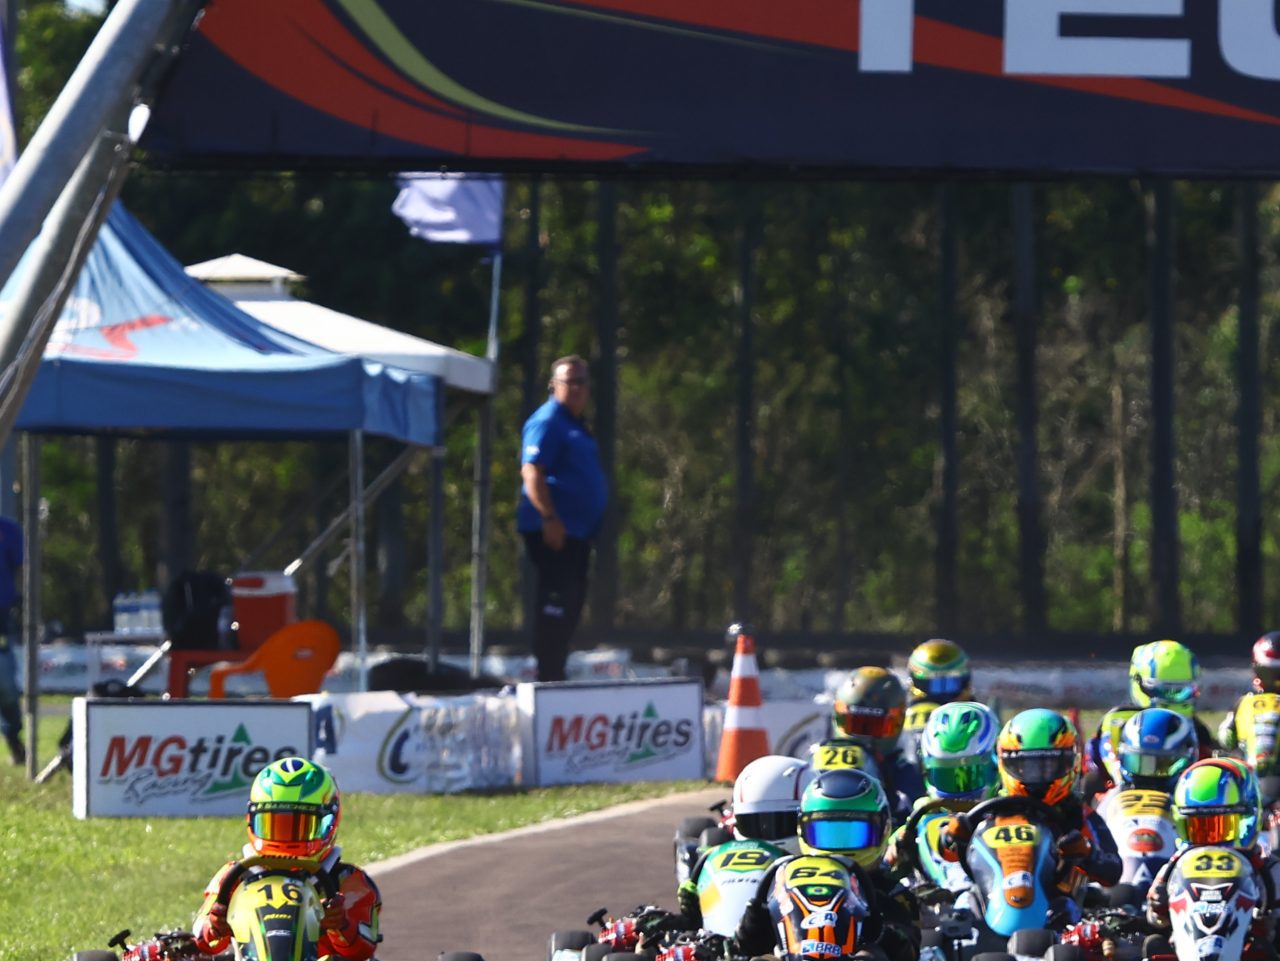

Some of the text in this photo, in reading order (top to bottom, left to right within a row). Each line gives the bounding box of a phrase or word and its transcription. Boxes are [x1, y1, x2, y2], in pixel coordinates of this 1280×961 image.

[545, 711, 693, 752] MGtires
[824, 749, 858, 767] 26
[994, 825, 1034, 842] 46
[719, 851, 771, 869] 19
[1194, 855, 1234, 872] 33
[789, 867, 844, 883] 64
[257, 883, 304, 903] 16
[815, 942, 841, 955] BRB
